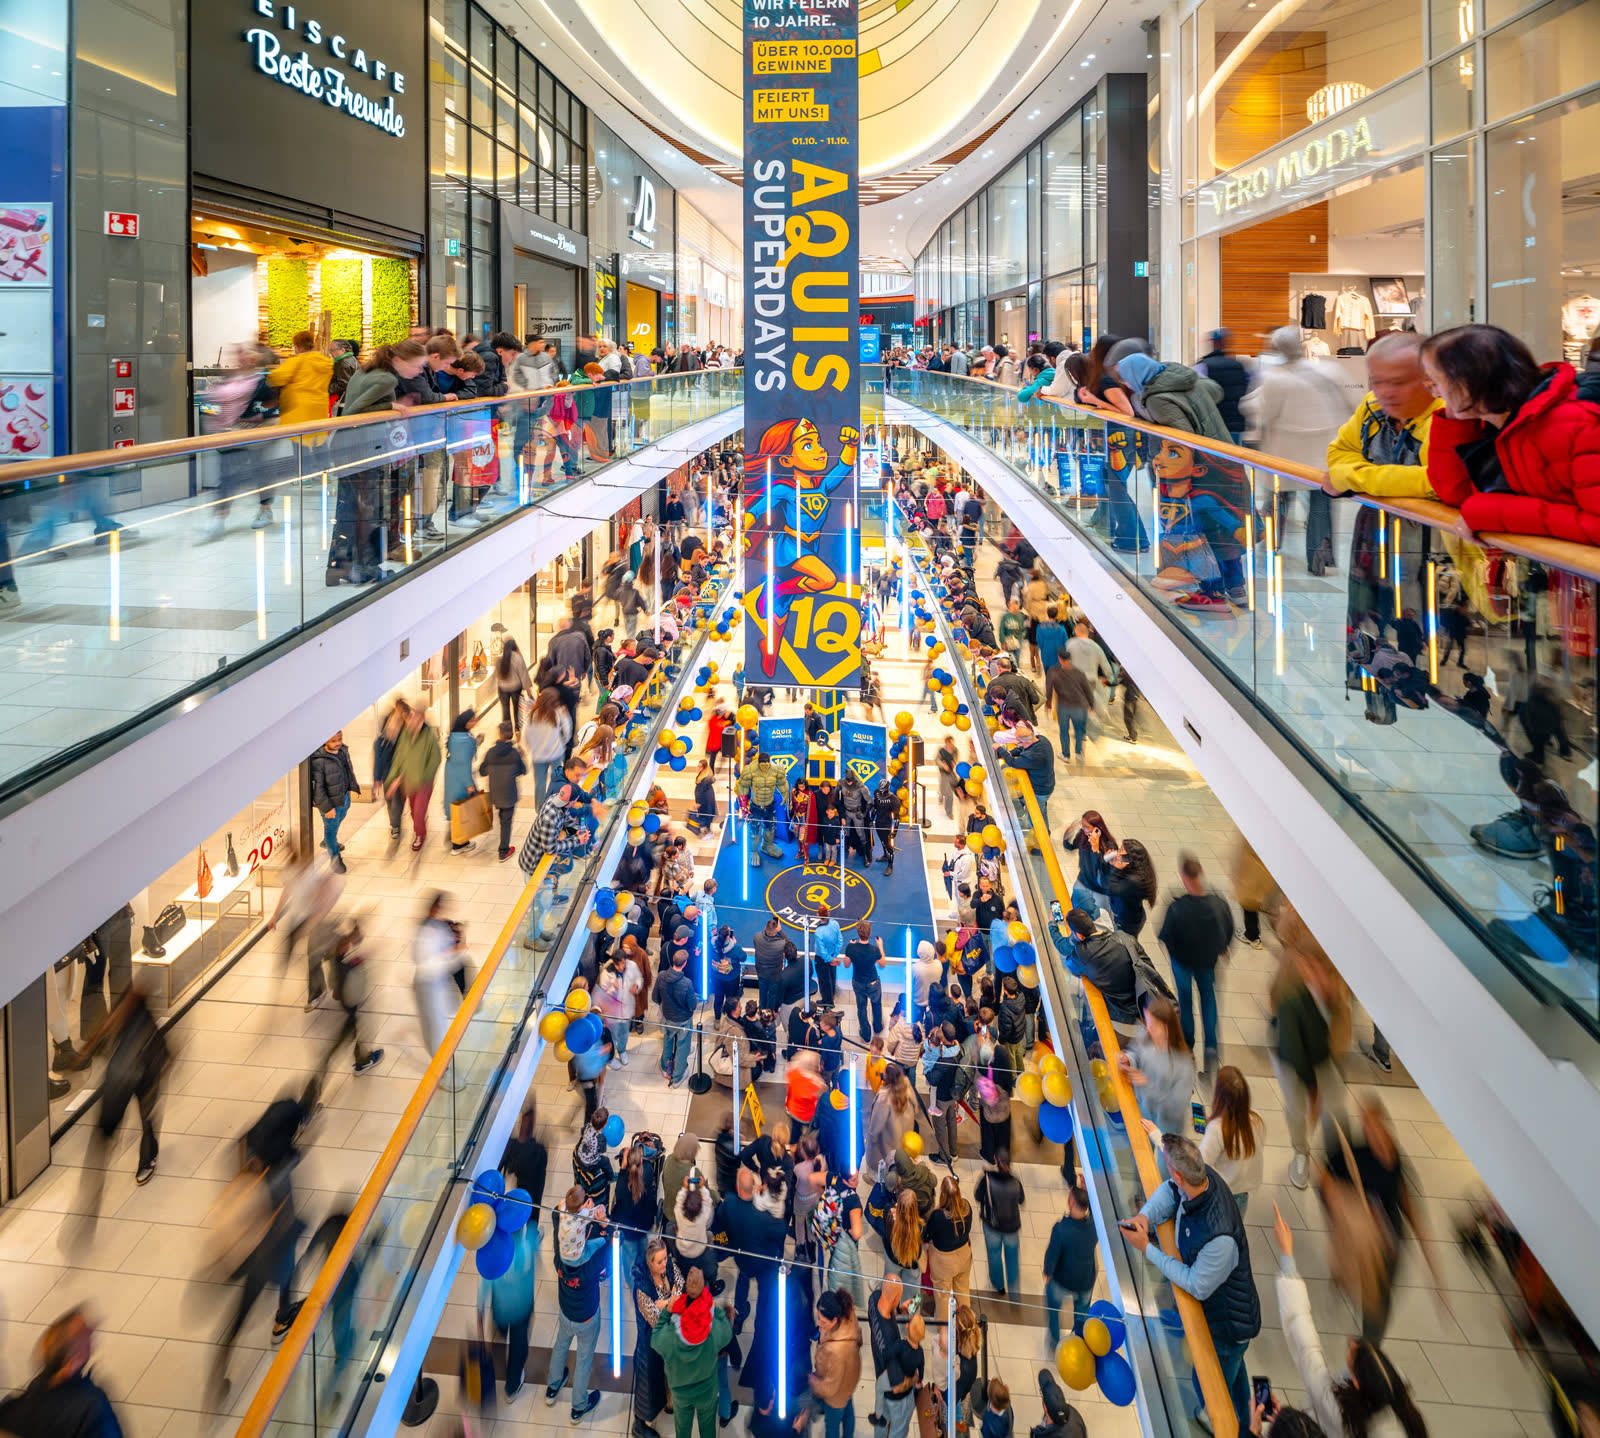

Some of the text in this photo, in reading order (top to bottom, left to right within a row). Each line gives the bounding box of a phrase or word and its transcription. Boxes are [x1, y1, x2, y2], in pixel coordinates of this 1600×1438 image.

[753, 0, 850, 10] WIR FEIERN
[753, 15, 836, 28] 10 JAHRE.
[757, 44, 853, 57] ÜBER 10.000
[757, 60, 827, 72] GEWINNE
[246, 28, 405, 138] Beste Freunde
[758, 92, 810, 103] FEIERT
[758, 107, 824, 119] MIT UNS!
[826, 137, 850, 145] 11.10.
[1212, 116, 1373, 217] VERO MODA
[635, 175, 656, 233] JD
[753, 159, 786, 392] SUPERDAYS
[774, 158, 850, 392] AQUIS
[532, 322, 573, 335] Denim
[632, 323, 651, 336] JD
[771, 728, 792, 736] AQUIS
[853, 732, 873, 741] AQUIS
[802, 866, 860, 887] AQUIS
[778, 906, 821, 928] PLAZ
